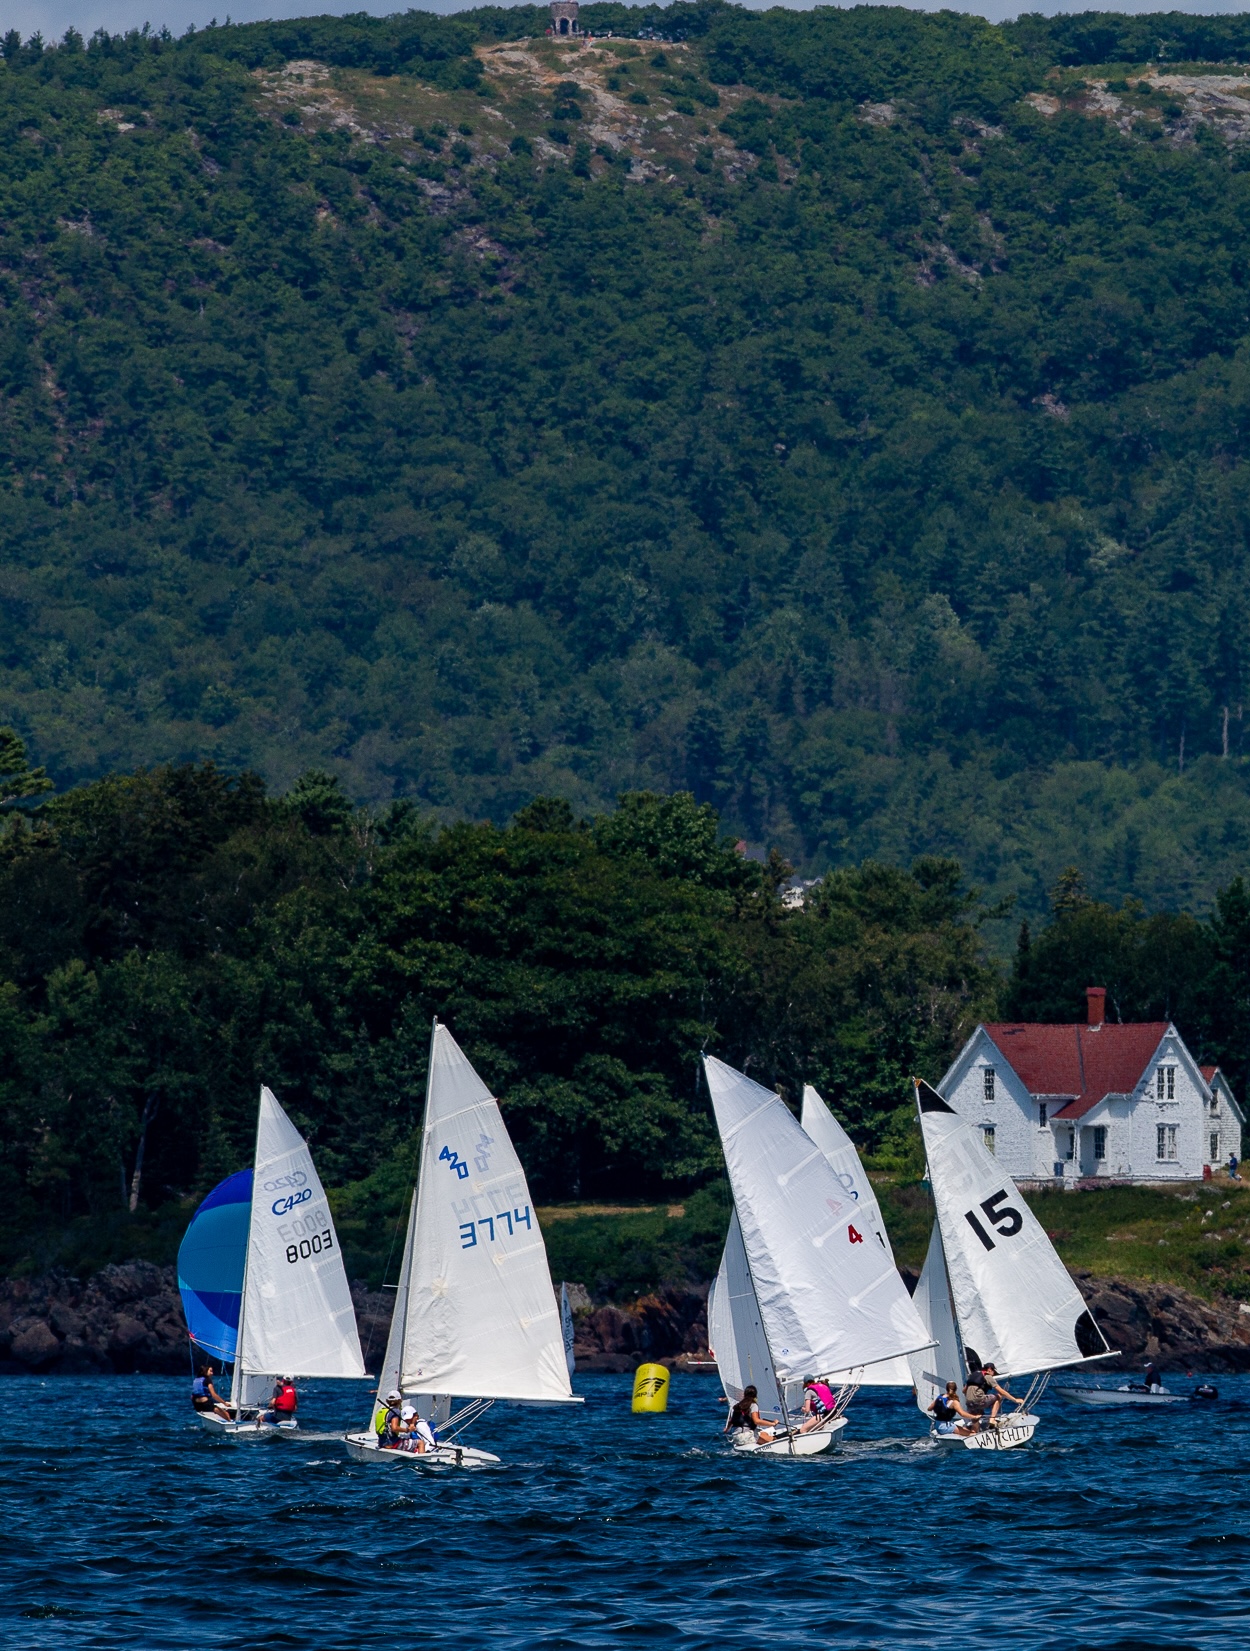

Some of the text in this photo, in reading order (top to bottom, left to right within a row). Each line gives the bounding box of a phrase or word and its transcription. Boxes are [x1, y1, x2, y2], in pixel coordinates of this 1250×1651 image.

[439, 1146, 469, 1179] 420
[272, 1188, 312, 1215] C420
[459, 1206, 531, 1249] 3774
[848, 1224, 863, 1244] 4
[964, 1189, 1023, 1252] 15
[286, 1229, 333, 1264] 8003
